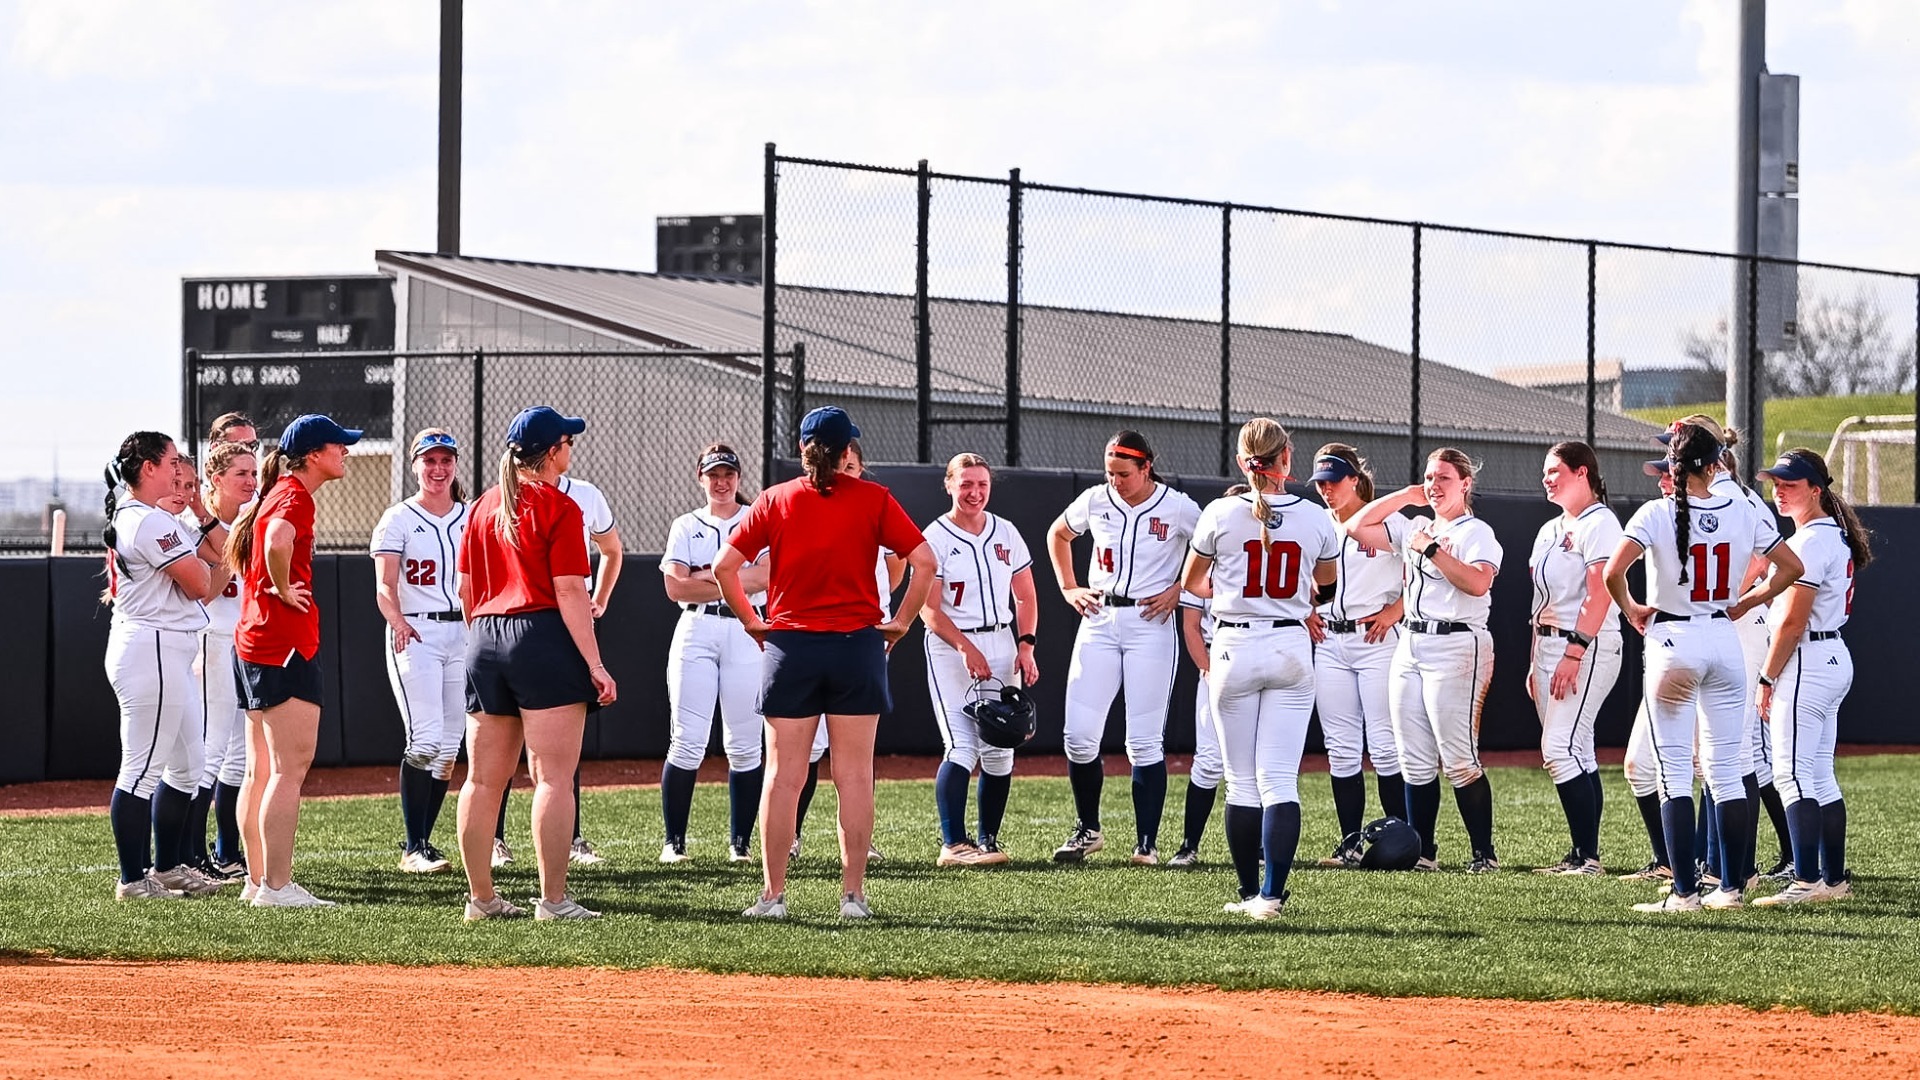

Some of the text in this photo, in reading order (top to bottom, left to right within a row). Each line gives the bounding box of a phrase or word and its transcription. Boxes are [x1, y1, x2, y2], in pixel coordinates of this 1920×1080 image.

[198, 283, 267, 310] HOME
[405, 558, 437, 586] 22
[1242, 539, 1302, 599] 10
[1689, 542, 1731, 603] 11
[949, 581, 965, 607] 7
